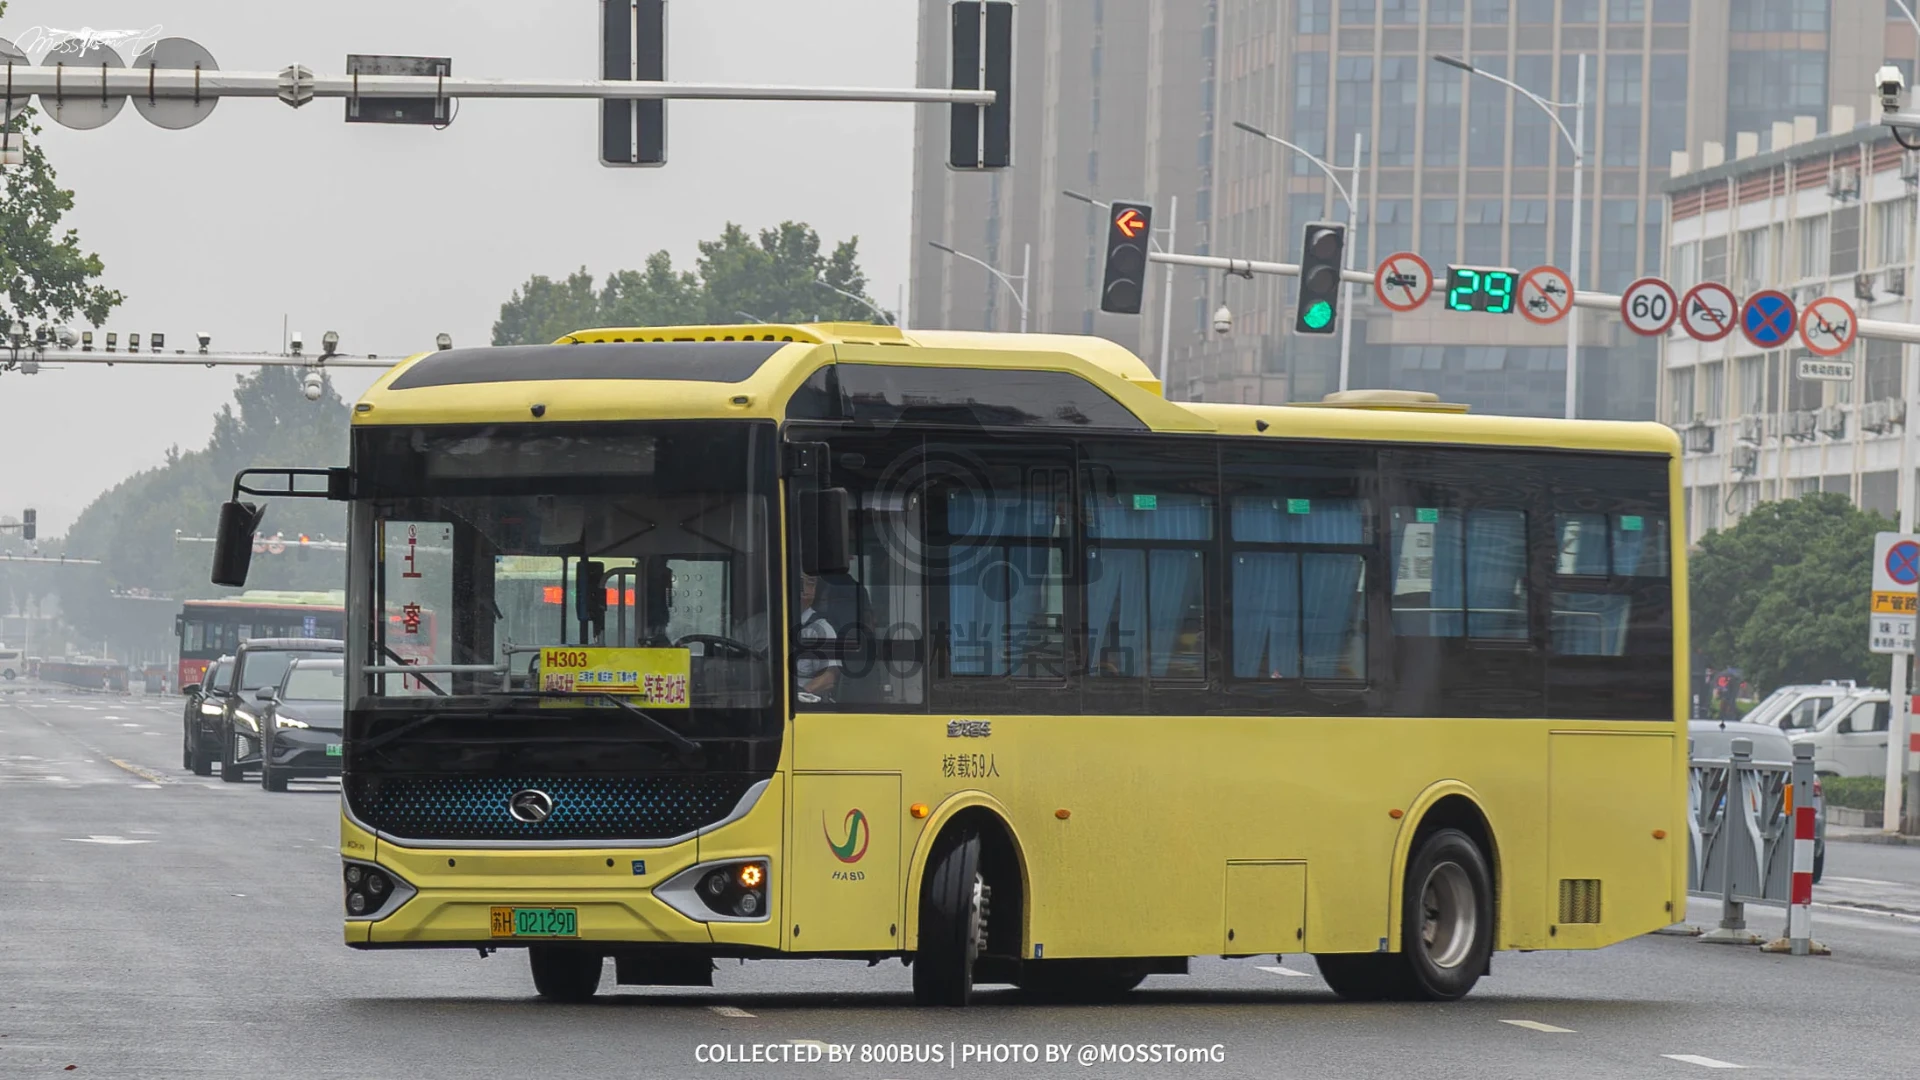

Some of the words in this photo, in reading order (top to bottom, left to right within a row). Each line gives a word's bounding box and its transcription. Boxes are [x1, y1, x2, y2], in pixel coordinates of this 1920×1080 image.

[1450, 269, 1512, 313] 29
[1632, 294, 1666, 321] 60
[546, 651, 587, 668] H303
[644, 674, 686, 704] 汽车北站
[947, 720, 992, 738] 金龙客车
[942, 754, 1000, 778] 核载59人
